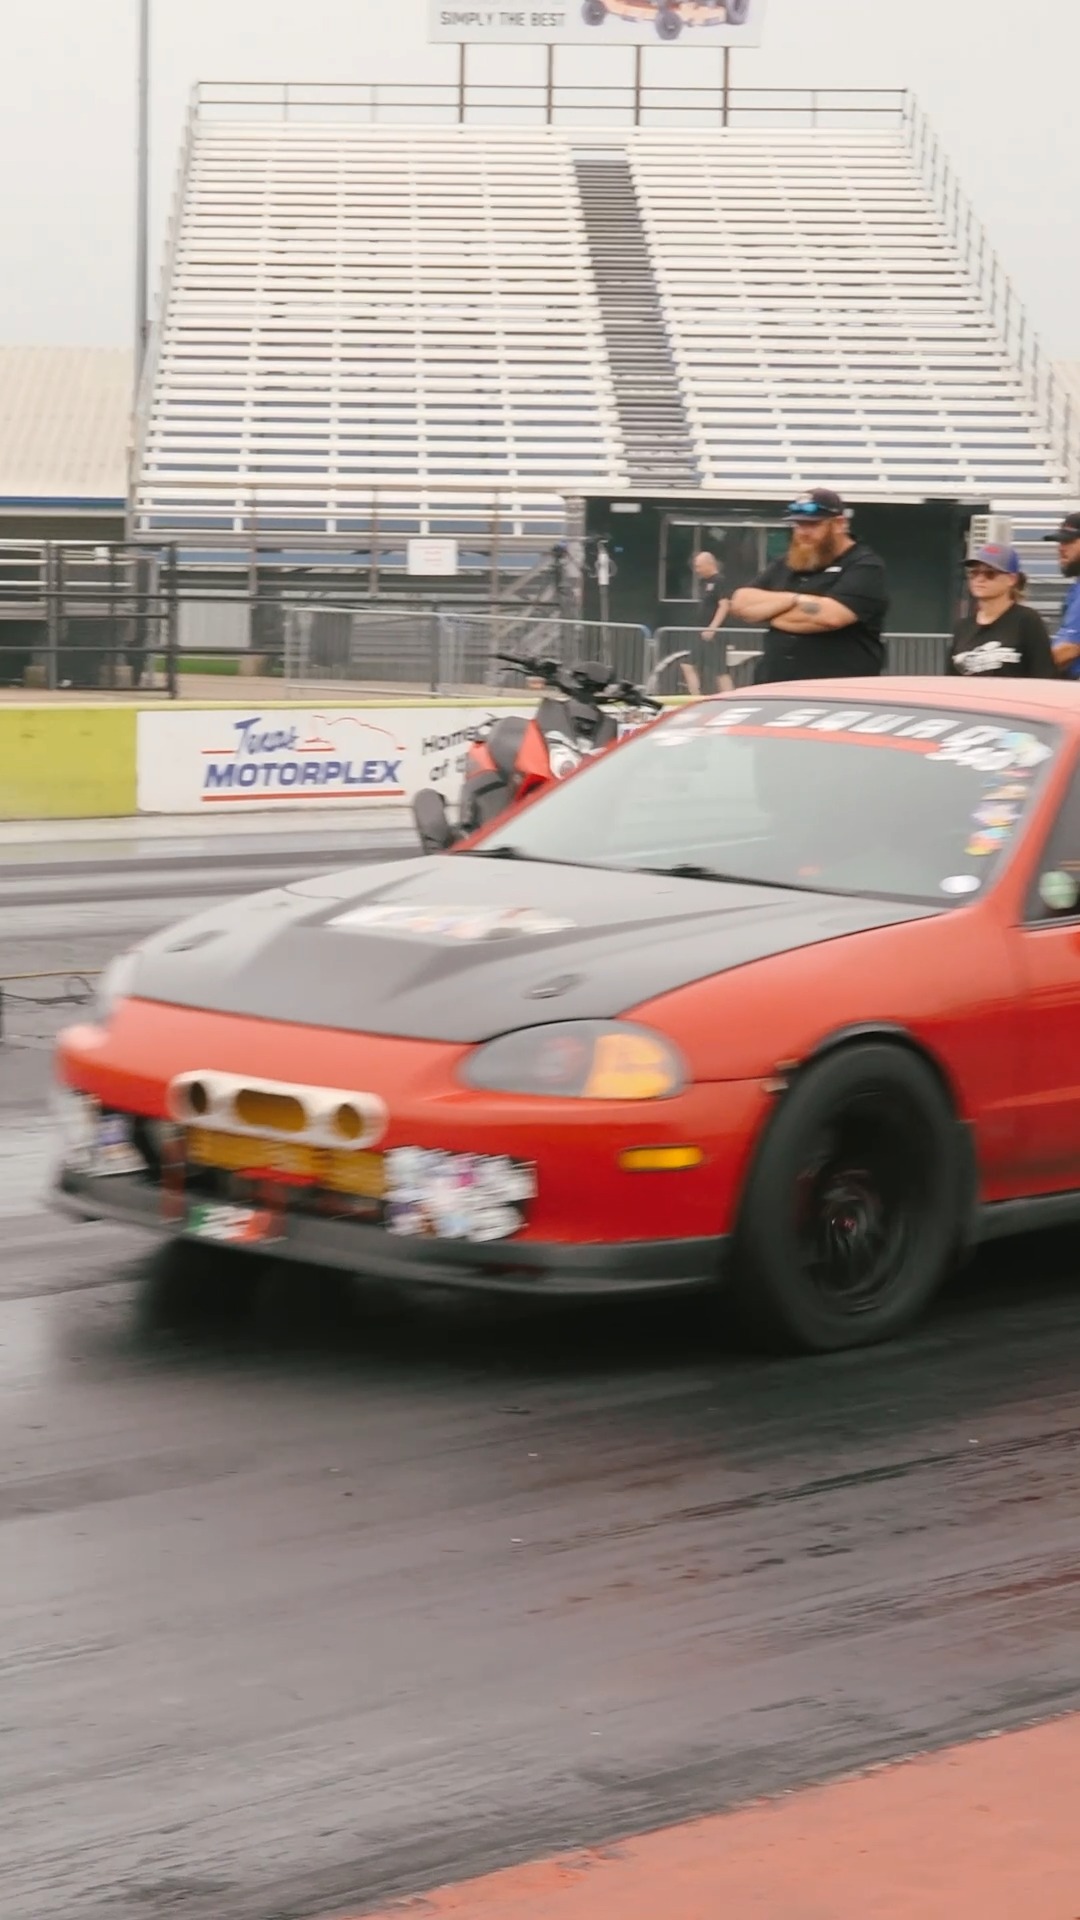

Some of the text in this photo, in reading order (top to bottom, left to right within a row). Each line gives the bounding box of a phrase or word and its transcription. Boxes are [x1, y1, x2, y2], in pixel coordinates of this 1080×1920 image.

[440, 11, 565, 27] SIMPLY THE BEST
[204, 760, 402, 788] MOTORPLEX
[428, 758, 451, 781] of
